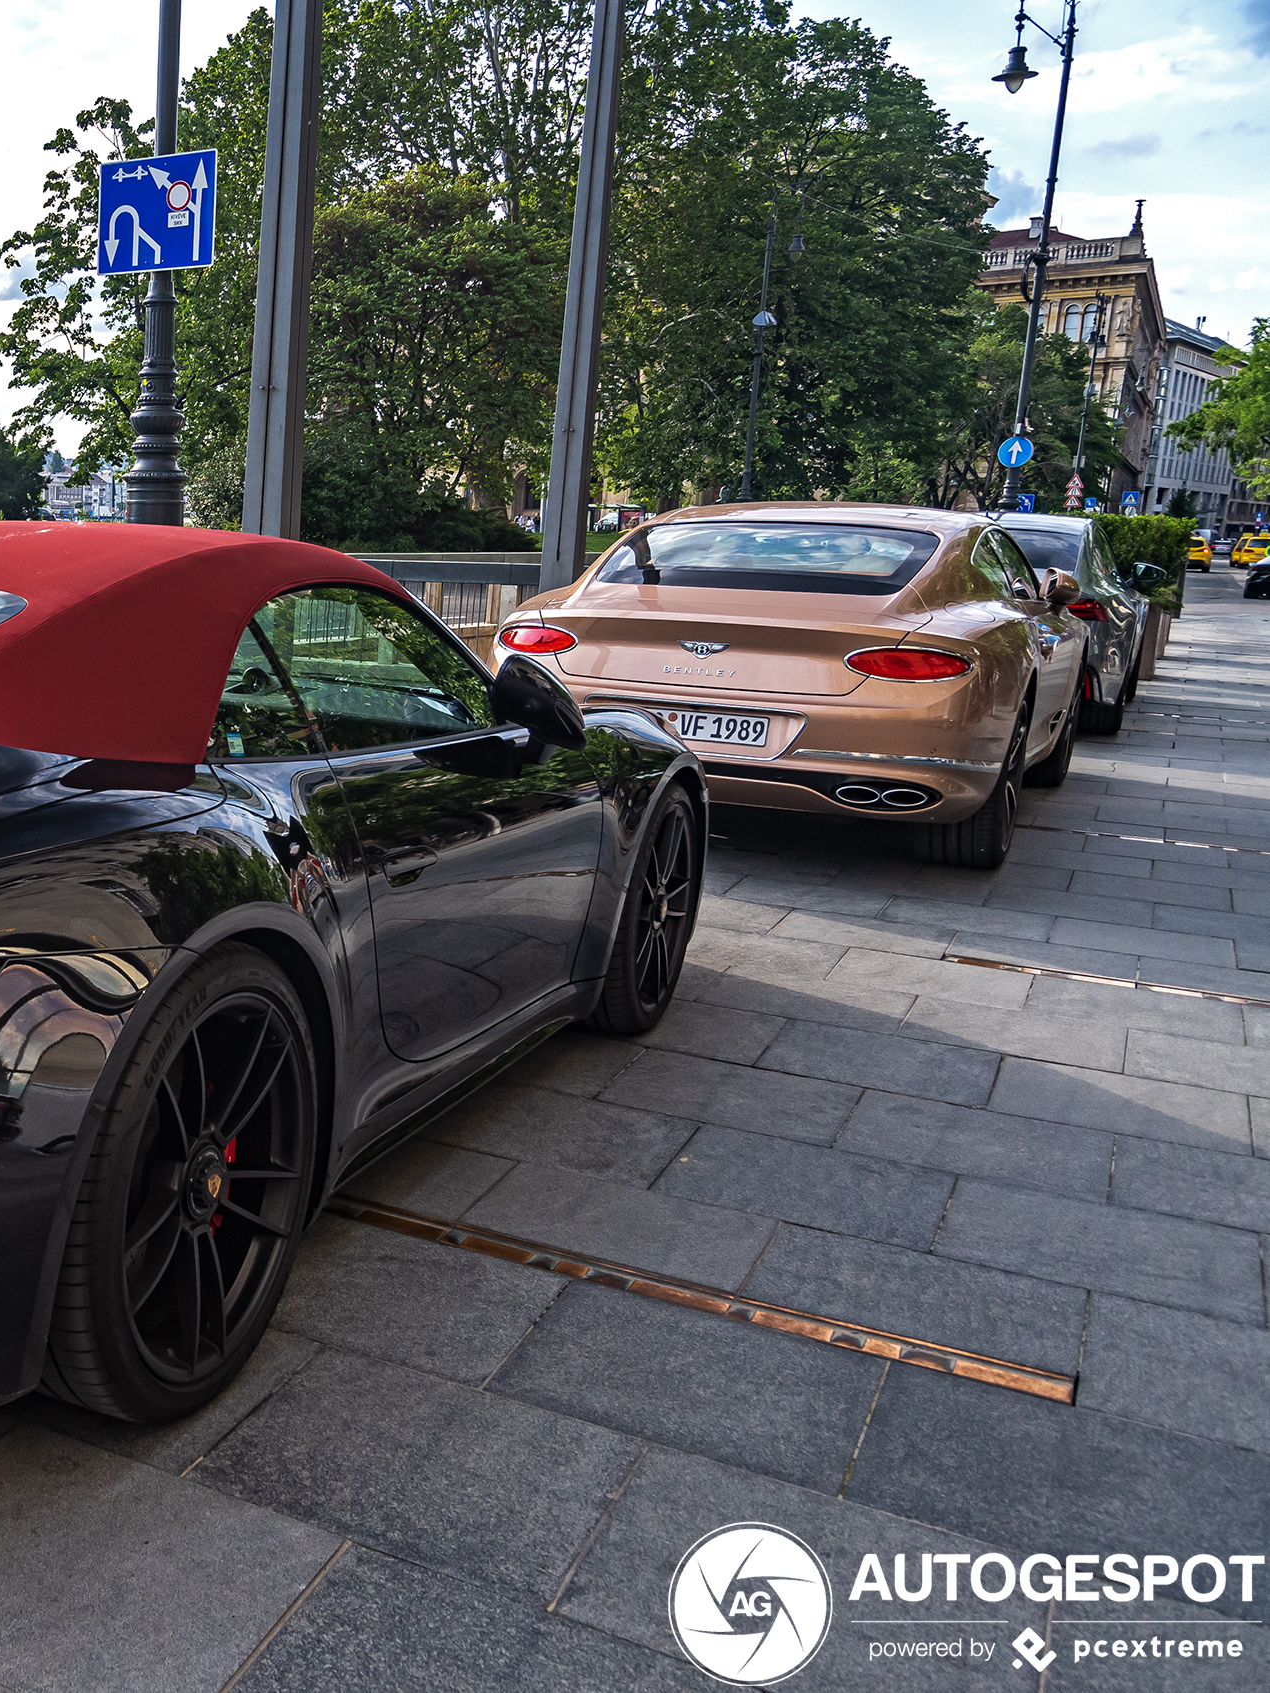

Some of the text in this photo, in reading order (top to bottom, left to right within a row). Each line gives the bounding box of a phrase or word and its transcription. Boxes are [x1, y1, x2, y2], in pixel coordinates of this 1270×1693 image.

[663, 665, 736, 678] BENTLEY
[681, 714, 766, 742] VF 1989
